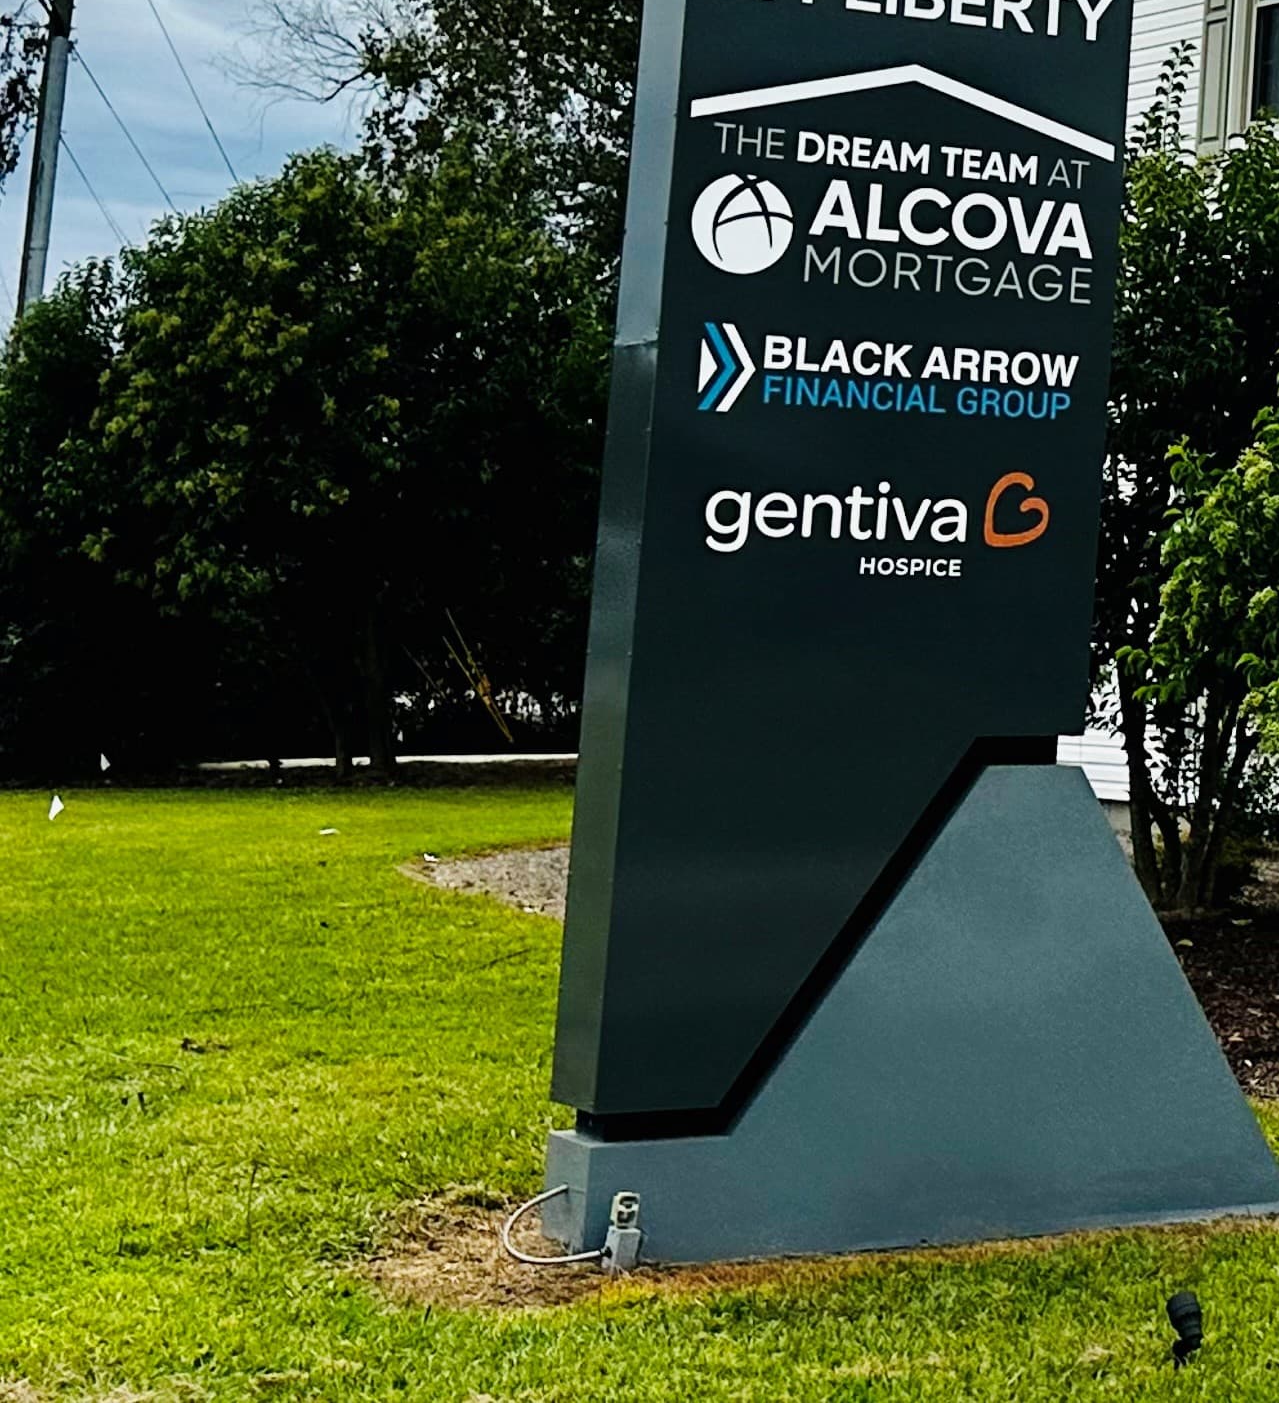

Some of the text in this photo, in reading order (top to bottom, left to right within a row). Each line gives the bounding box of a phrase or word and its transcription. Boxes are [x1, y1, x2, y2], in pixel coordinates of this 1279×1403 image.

[714, 122, 1091, 189] THE DREAM TEAM AT
[808, 179, 1093, 260] ALCOVA
[803, 244, 1093, 305] MORTGAGE
[763, 334, 1080, 388] BLACK ARROW
[762, 375, 1071, 420] FINANCIAL GROUP
[705, 481, 968, 553] gentiva
[859, 556, 962, 578] HOSPICE
